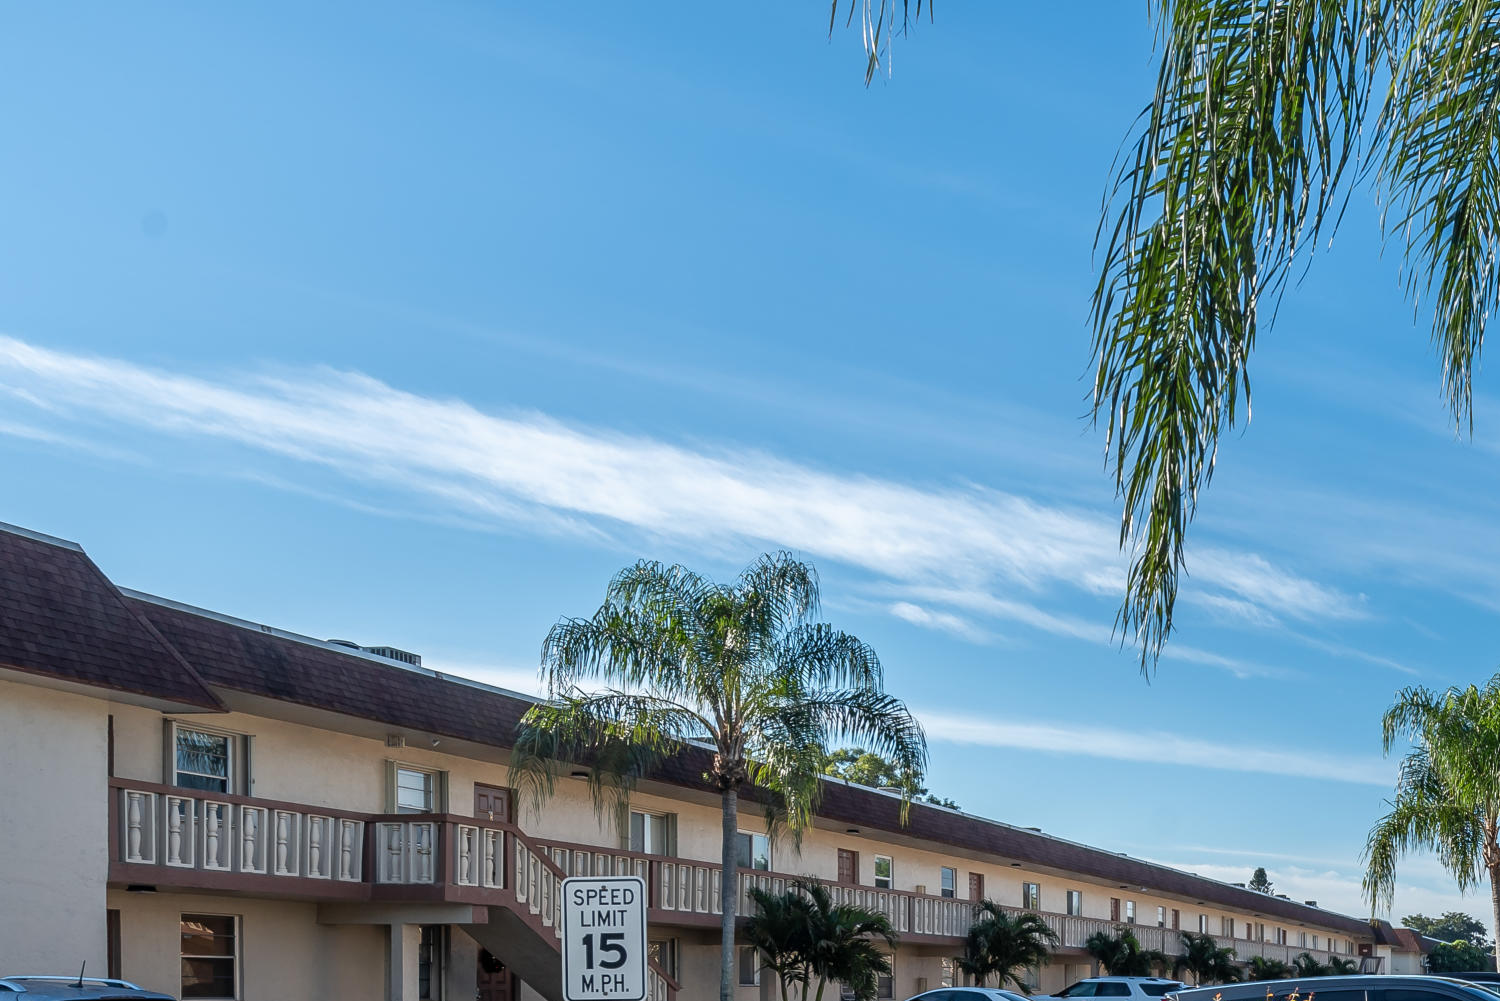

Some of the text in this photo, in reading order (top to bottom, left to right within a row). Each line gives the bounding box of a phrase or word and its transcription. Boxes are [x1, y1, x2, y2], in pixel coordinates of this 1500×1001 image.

[573, 888, 635, 906] SPEED
[580, 910, 628, 927] LIMIT
[582, 932, 628, 970] 15
[581, 974, 630, 993] M.P.H.
